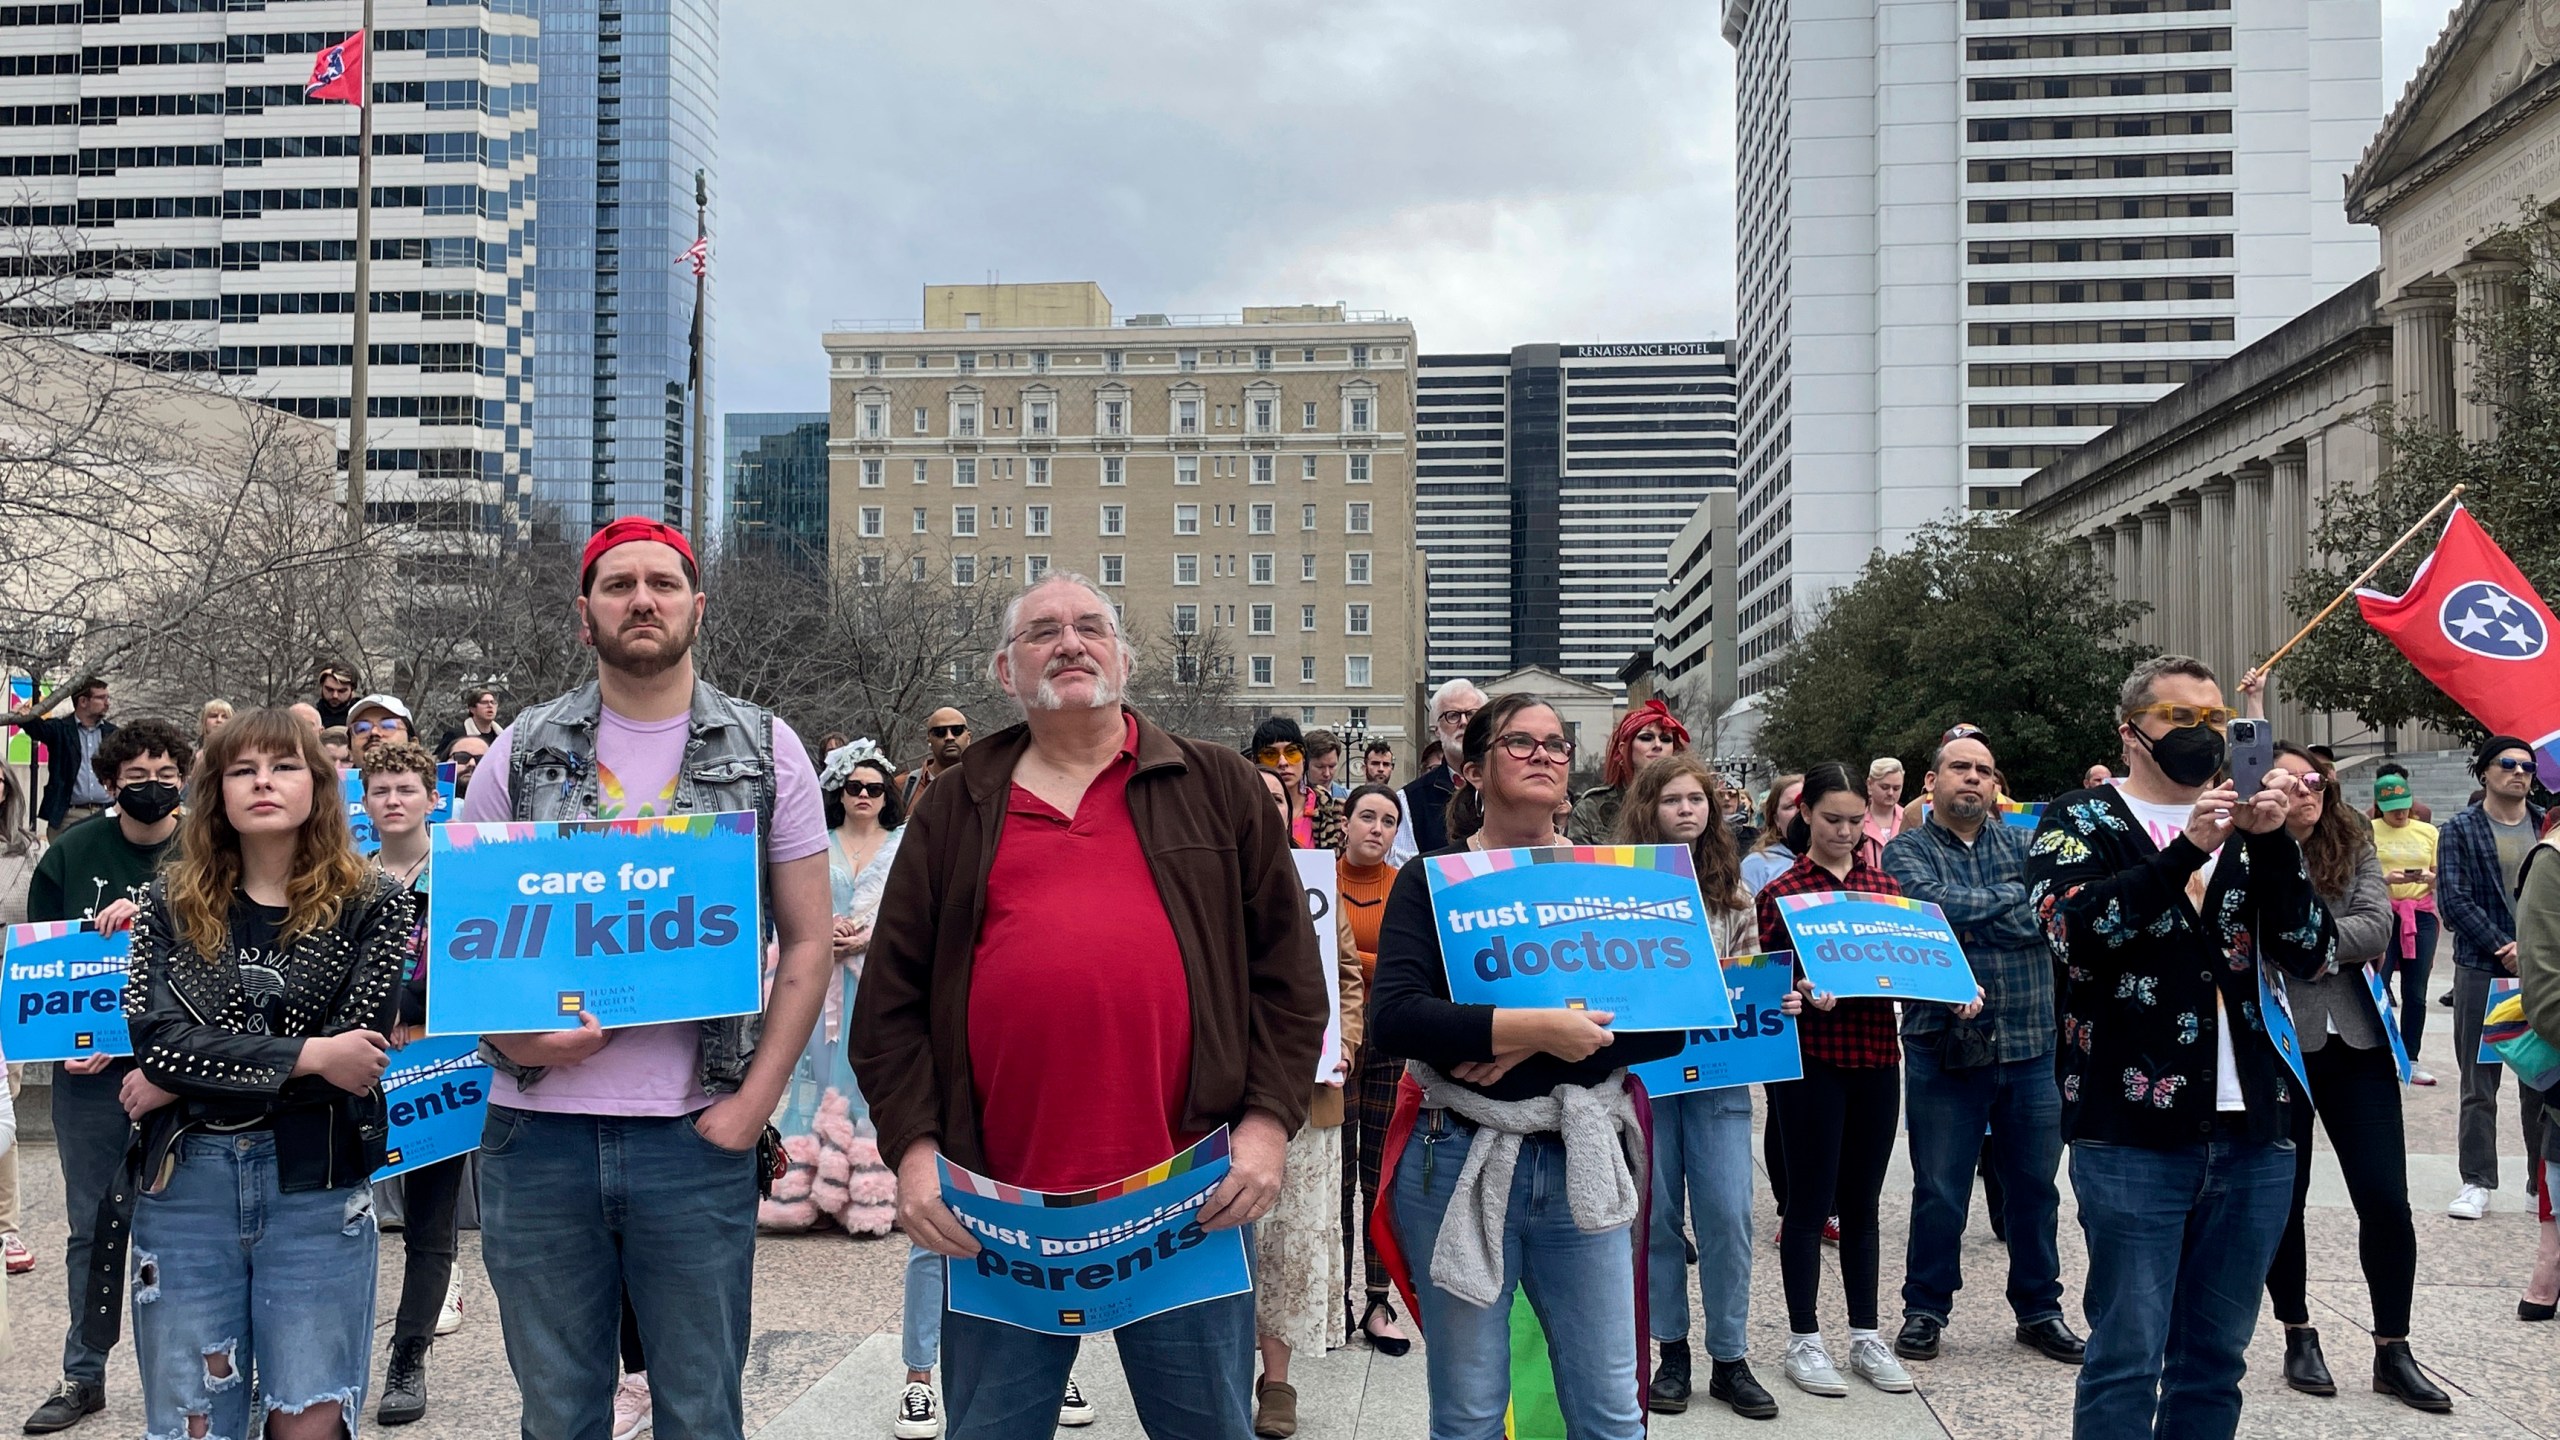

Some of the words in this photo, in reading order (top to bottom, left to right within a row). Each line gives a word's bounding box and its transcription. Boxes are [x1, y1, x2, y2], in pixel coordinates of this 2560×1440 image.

[1578, 344, 1663, 357] RENAISSANCE
[1668, 343, 1709, 355] HOTEL
[517, 871, 606, 896] care
[617, 862, 675, 892] for
[448, 903, 553, 961] all
[574, 895, 740, 958] kids
[1448, 901, 1529, 933] trust
[1536, 896, 1693, 927] politicians
[1796, 920, 1848, 936] trust
[1851, 921, 1950, 943] politicians
[10, 959, 65, 980] trust
[1473, 931, 1692, 982] doctors
[1816, 938, 1953, 968] doctors
[18, 988, 128, 1024] pare
[590, 985, 635, 996] HUMAN
[590, 996, 635, 1007] RIGHTS
[389, 1080, 482, 1127] ents
[952, 1204, 1031, 1249] trust
[976, 1220, 1208, 1291] parents
